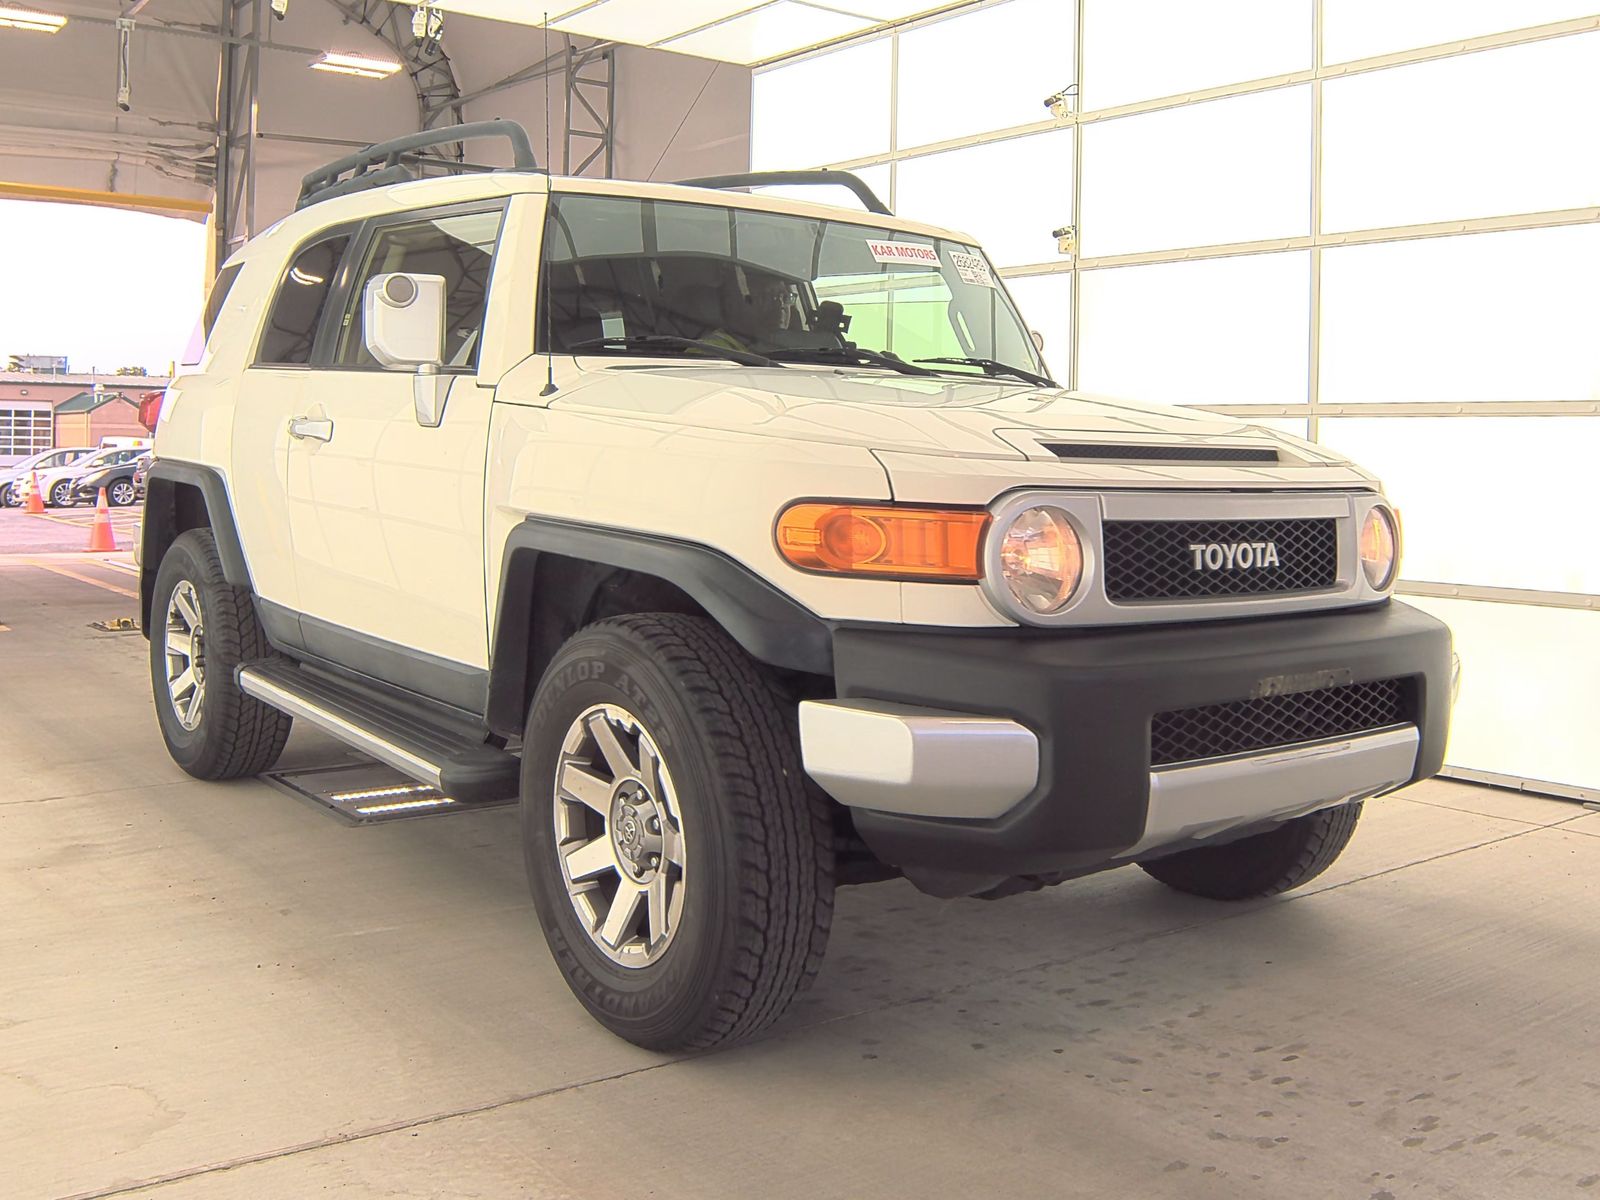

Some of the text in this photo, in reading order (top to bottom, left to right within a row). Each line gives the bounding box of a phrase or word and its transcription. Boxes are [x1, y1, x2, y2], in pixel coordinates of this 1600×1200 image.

[871, 244, 937, 260] KAR MOTORS
[1189, 542, 1280, 570] TOYOTA
[536, 660, 605, 729] DUNLOP
